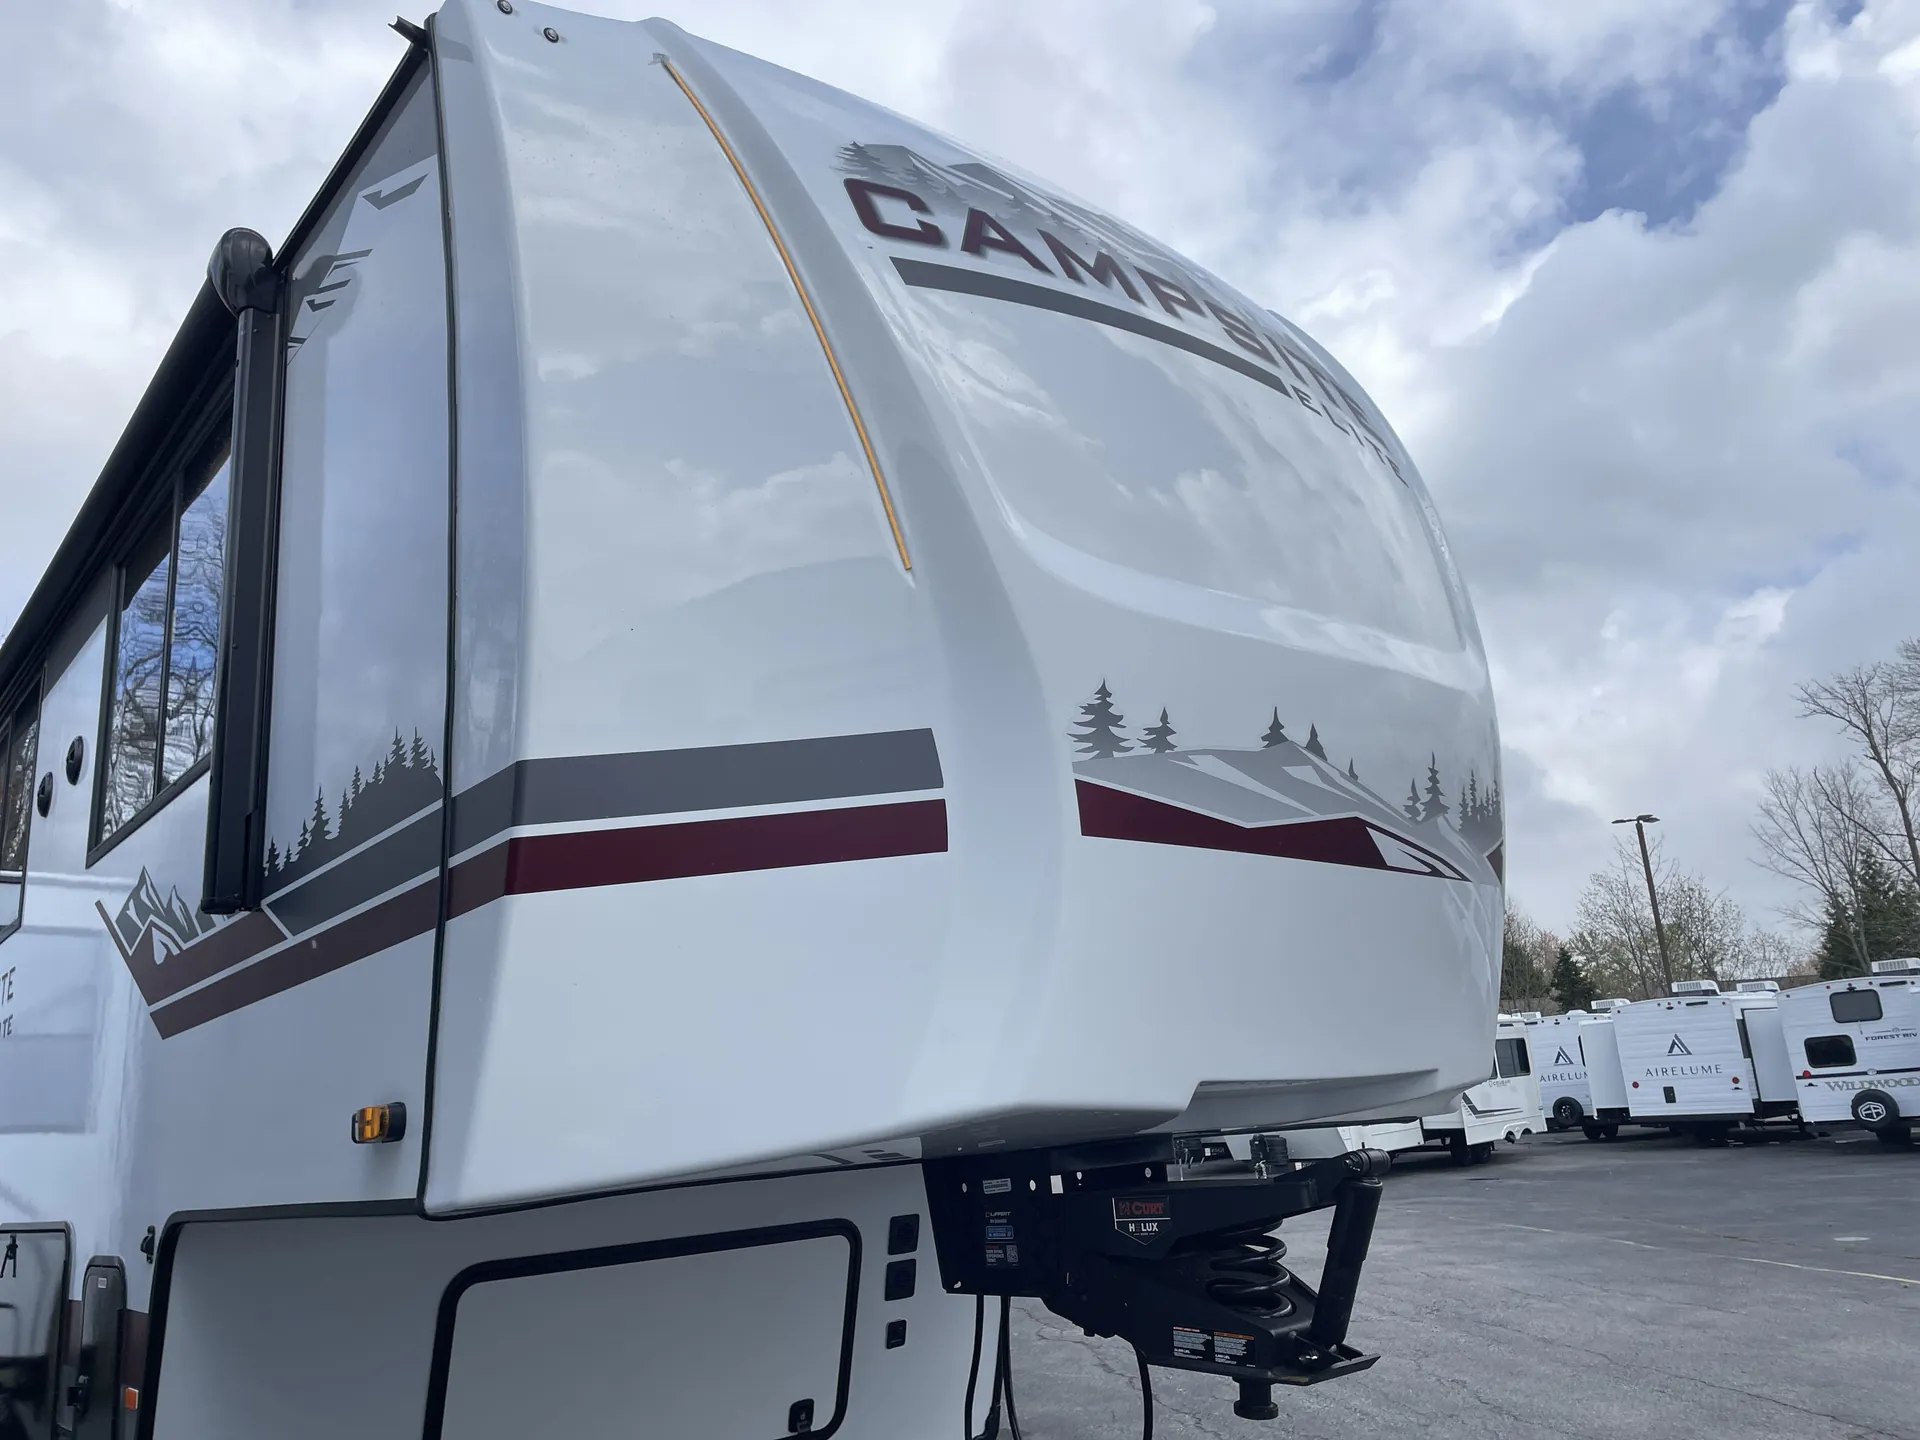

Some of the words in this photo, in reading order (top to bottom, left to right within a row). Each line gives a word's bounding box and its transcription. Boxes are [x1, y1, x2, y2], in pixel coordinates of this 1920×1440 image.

[1290, 384, 1409, 488] ELITE
[1645, 1064, 1722, 1077] AIRELUME
[1825, 1077, 1920, 1091] WILDWOOD
